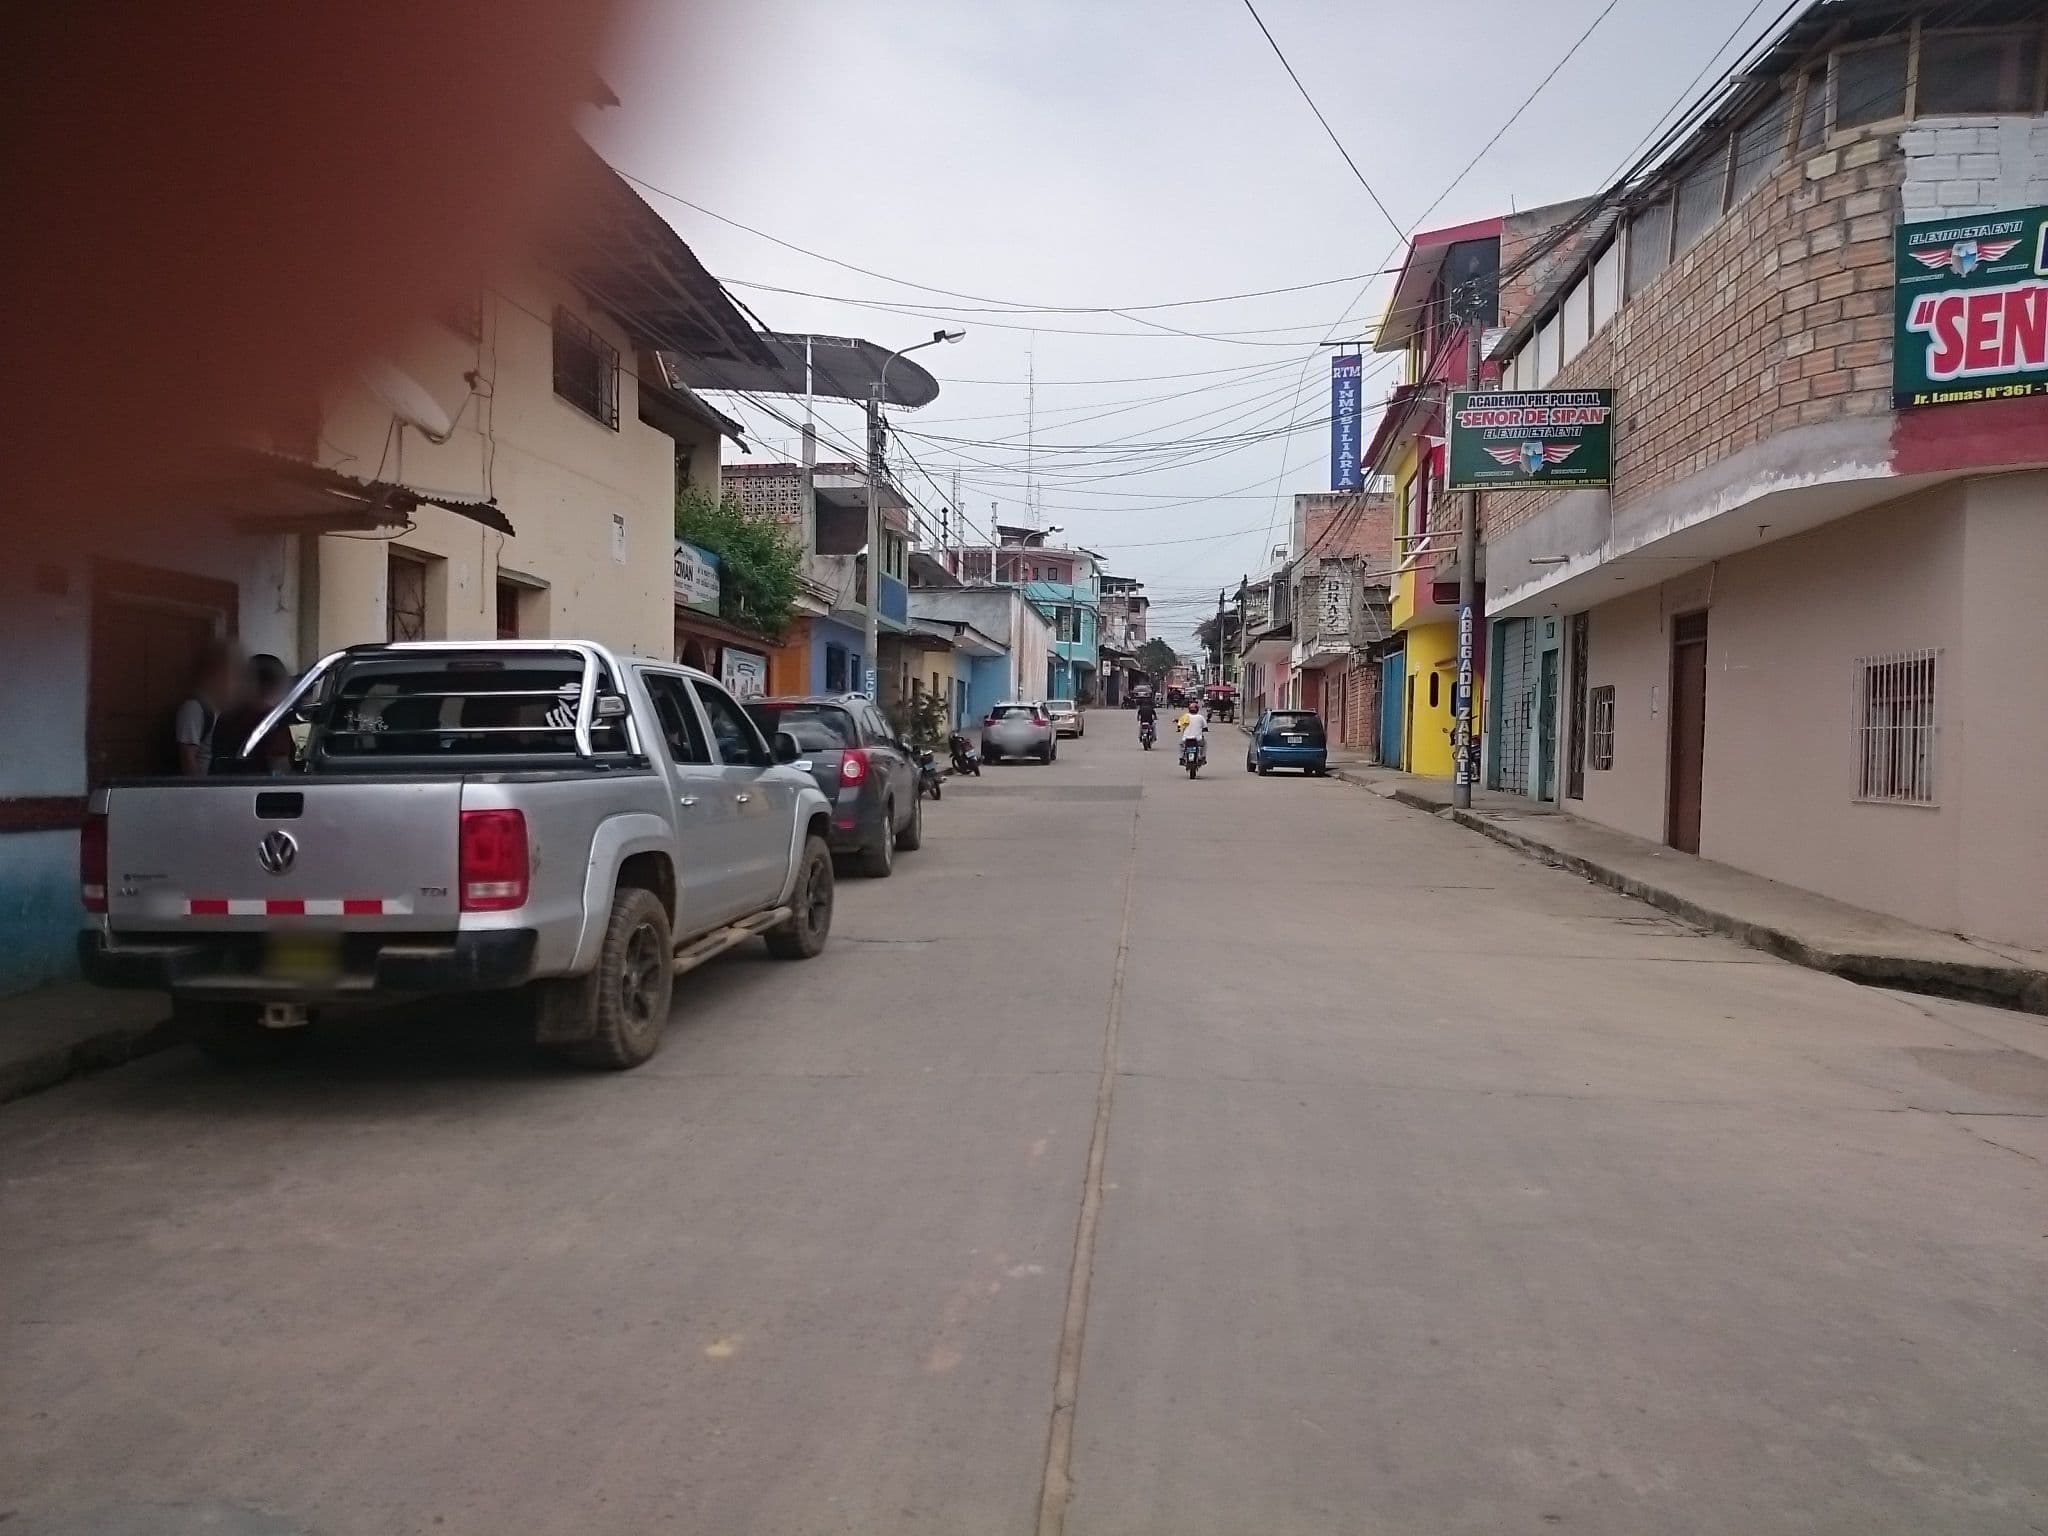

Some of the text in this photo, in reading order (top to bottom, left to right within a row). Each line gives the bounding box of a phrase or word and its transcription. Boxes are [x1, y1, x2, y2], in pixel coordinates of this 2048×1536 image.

[1908, 220, 2025, 246] EL EXITO ESTA EN TI
[1333, 366, 1361, 378] RTM
[1469, 392, 1600, 407] ACADEMIA PRE POLICIAL
[1913, 394, 1929, 405] Jr.
[1932, 390, 1982, 403] Lamas
[1524, 408, 1548, 425] DE
[1484, 428, 1499, 439] EL
[1499, 428, 1529, 438] EXITO
[1529, 427, 1556, 437] ESTA
[1456, 606, 1473, 785] ABOGADO ZARATE
